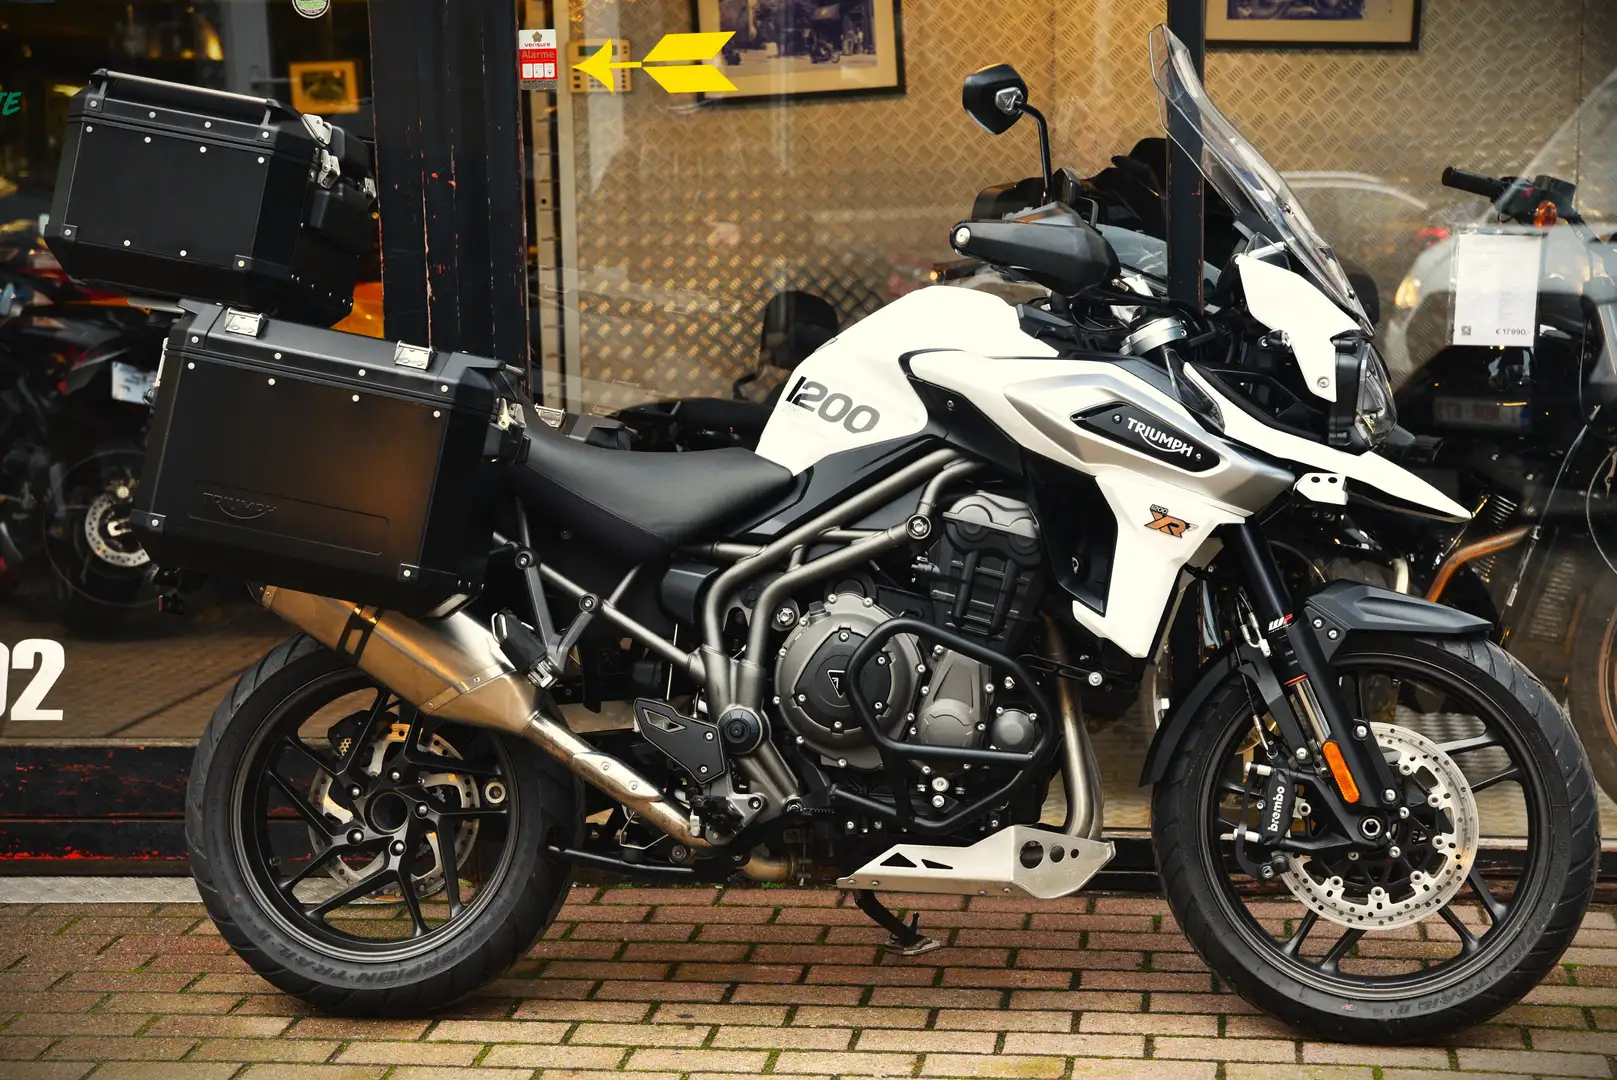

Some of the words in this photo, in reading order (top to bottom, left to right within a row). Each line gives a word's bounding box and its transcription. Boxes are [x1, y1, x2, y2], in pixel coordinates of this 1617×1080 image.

[522, 50, 555, 59] Alarme
[785, 376, 881, 434] 1200
[1127, 417, 1194, 458] TRIUMPH
[203, 492, 277, 519] TRIUMPH
[0, 638, 65, 721] 2
[1267, 785, 1285, 832] brembo
